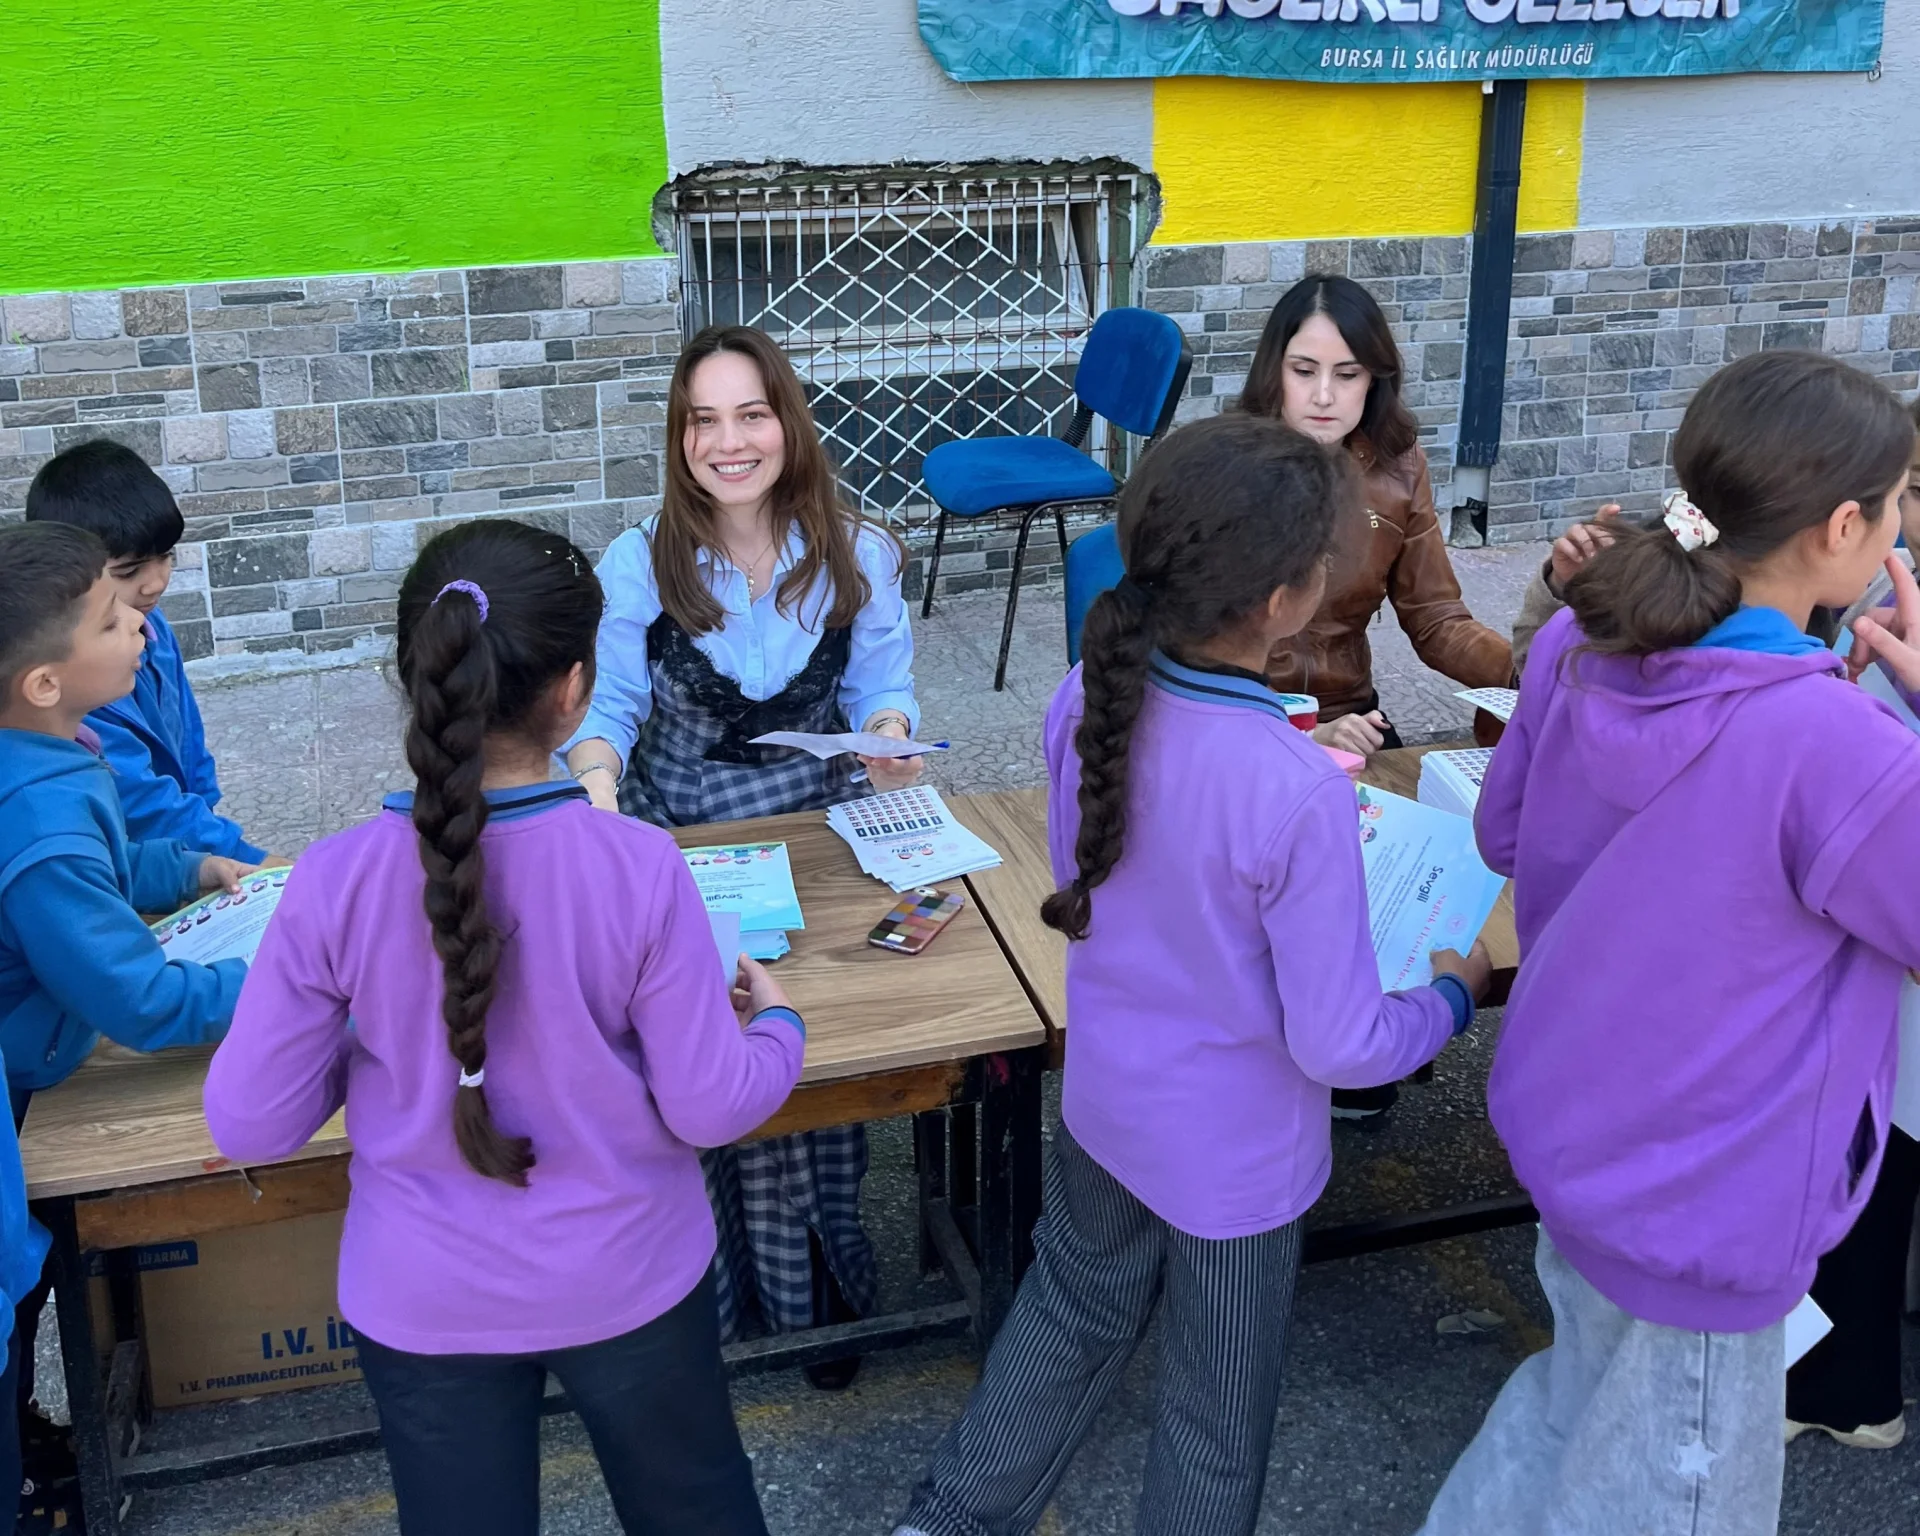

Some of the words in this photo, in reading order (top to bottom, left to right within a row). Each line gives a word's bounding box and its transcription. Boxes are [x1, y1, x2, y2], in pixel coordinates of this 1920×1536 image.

[1320, 48, 1384, 69] BURSA
[1391, 46, 1407, 69] İL
[1414, 46, 1479, 69] SAĞLIK
[1485, 42, 1595, 68] MÜDÜRLÜĞÜ
[1417, 865, 1444, 903] Sevgili
[261, 1326, 314, 1360] I.V.
[179, 1381, 202, 1394] I.V.
[206, 1361, 338, 1389] PHARMACEUTICAL
